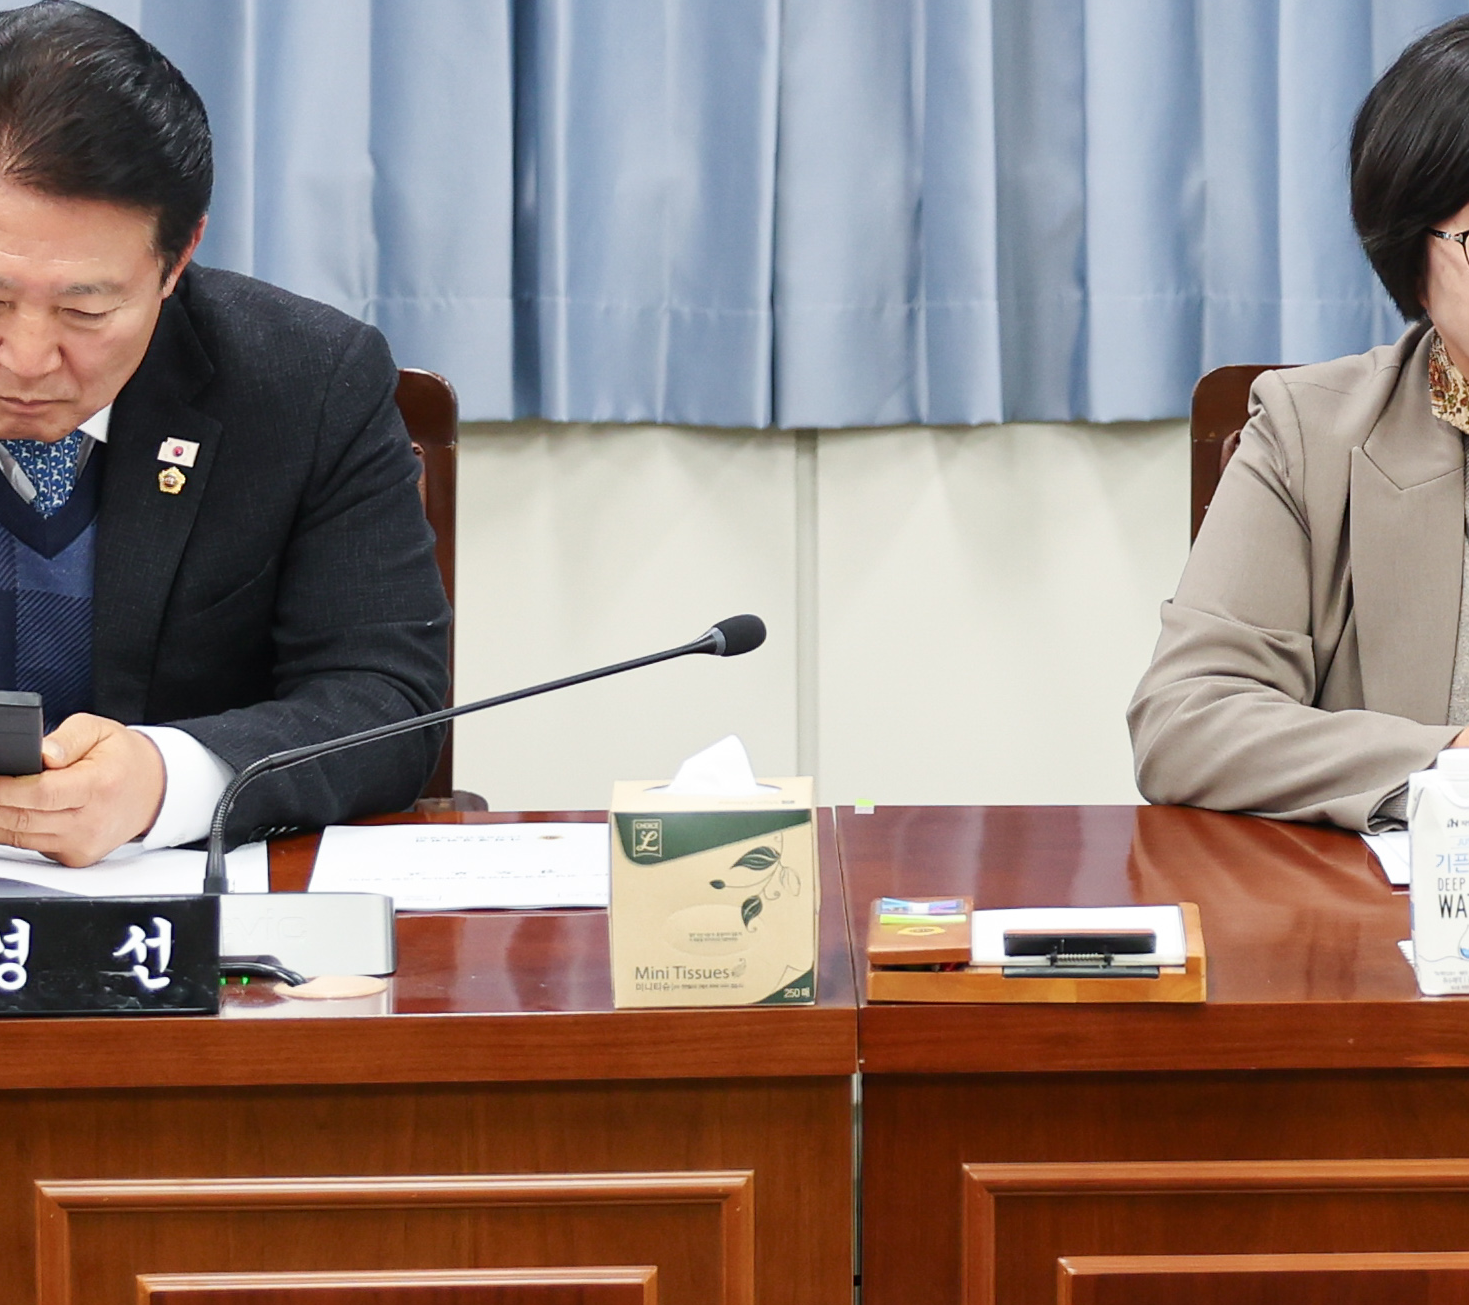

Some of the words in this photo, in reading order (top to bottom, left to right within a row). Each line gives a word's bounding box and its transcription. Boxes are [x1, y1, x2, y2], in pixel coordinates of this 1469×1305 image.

[1437, 877, 1466, 891] DEEP
[635, 966, 669, 980] Mini
[673, 965, 730, 980] Tissues
